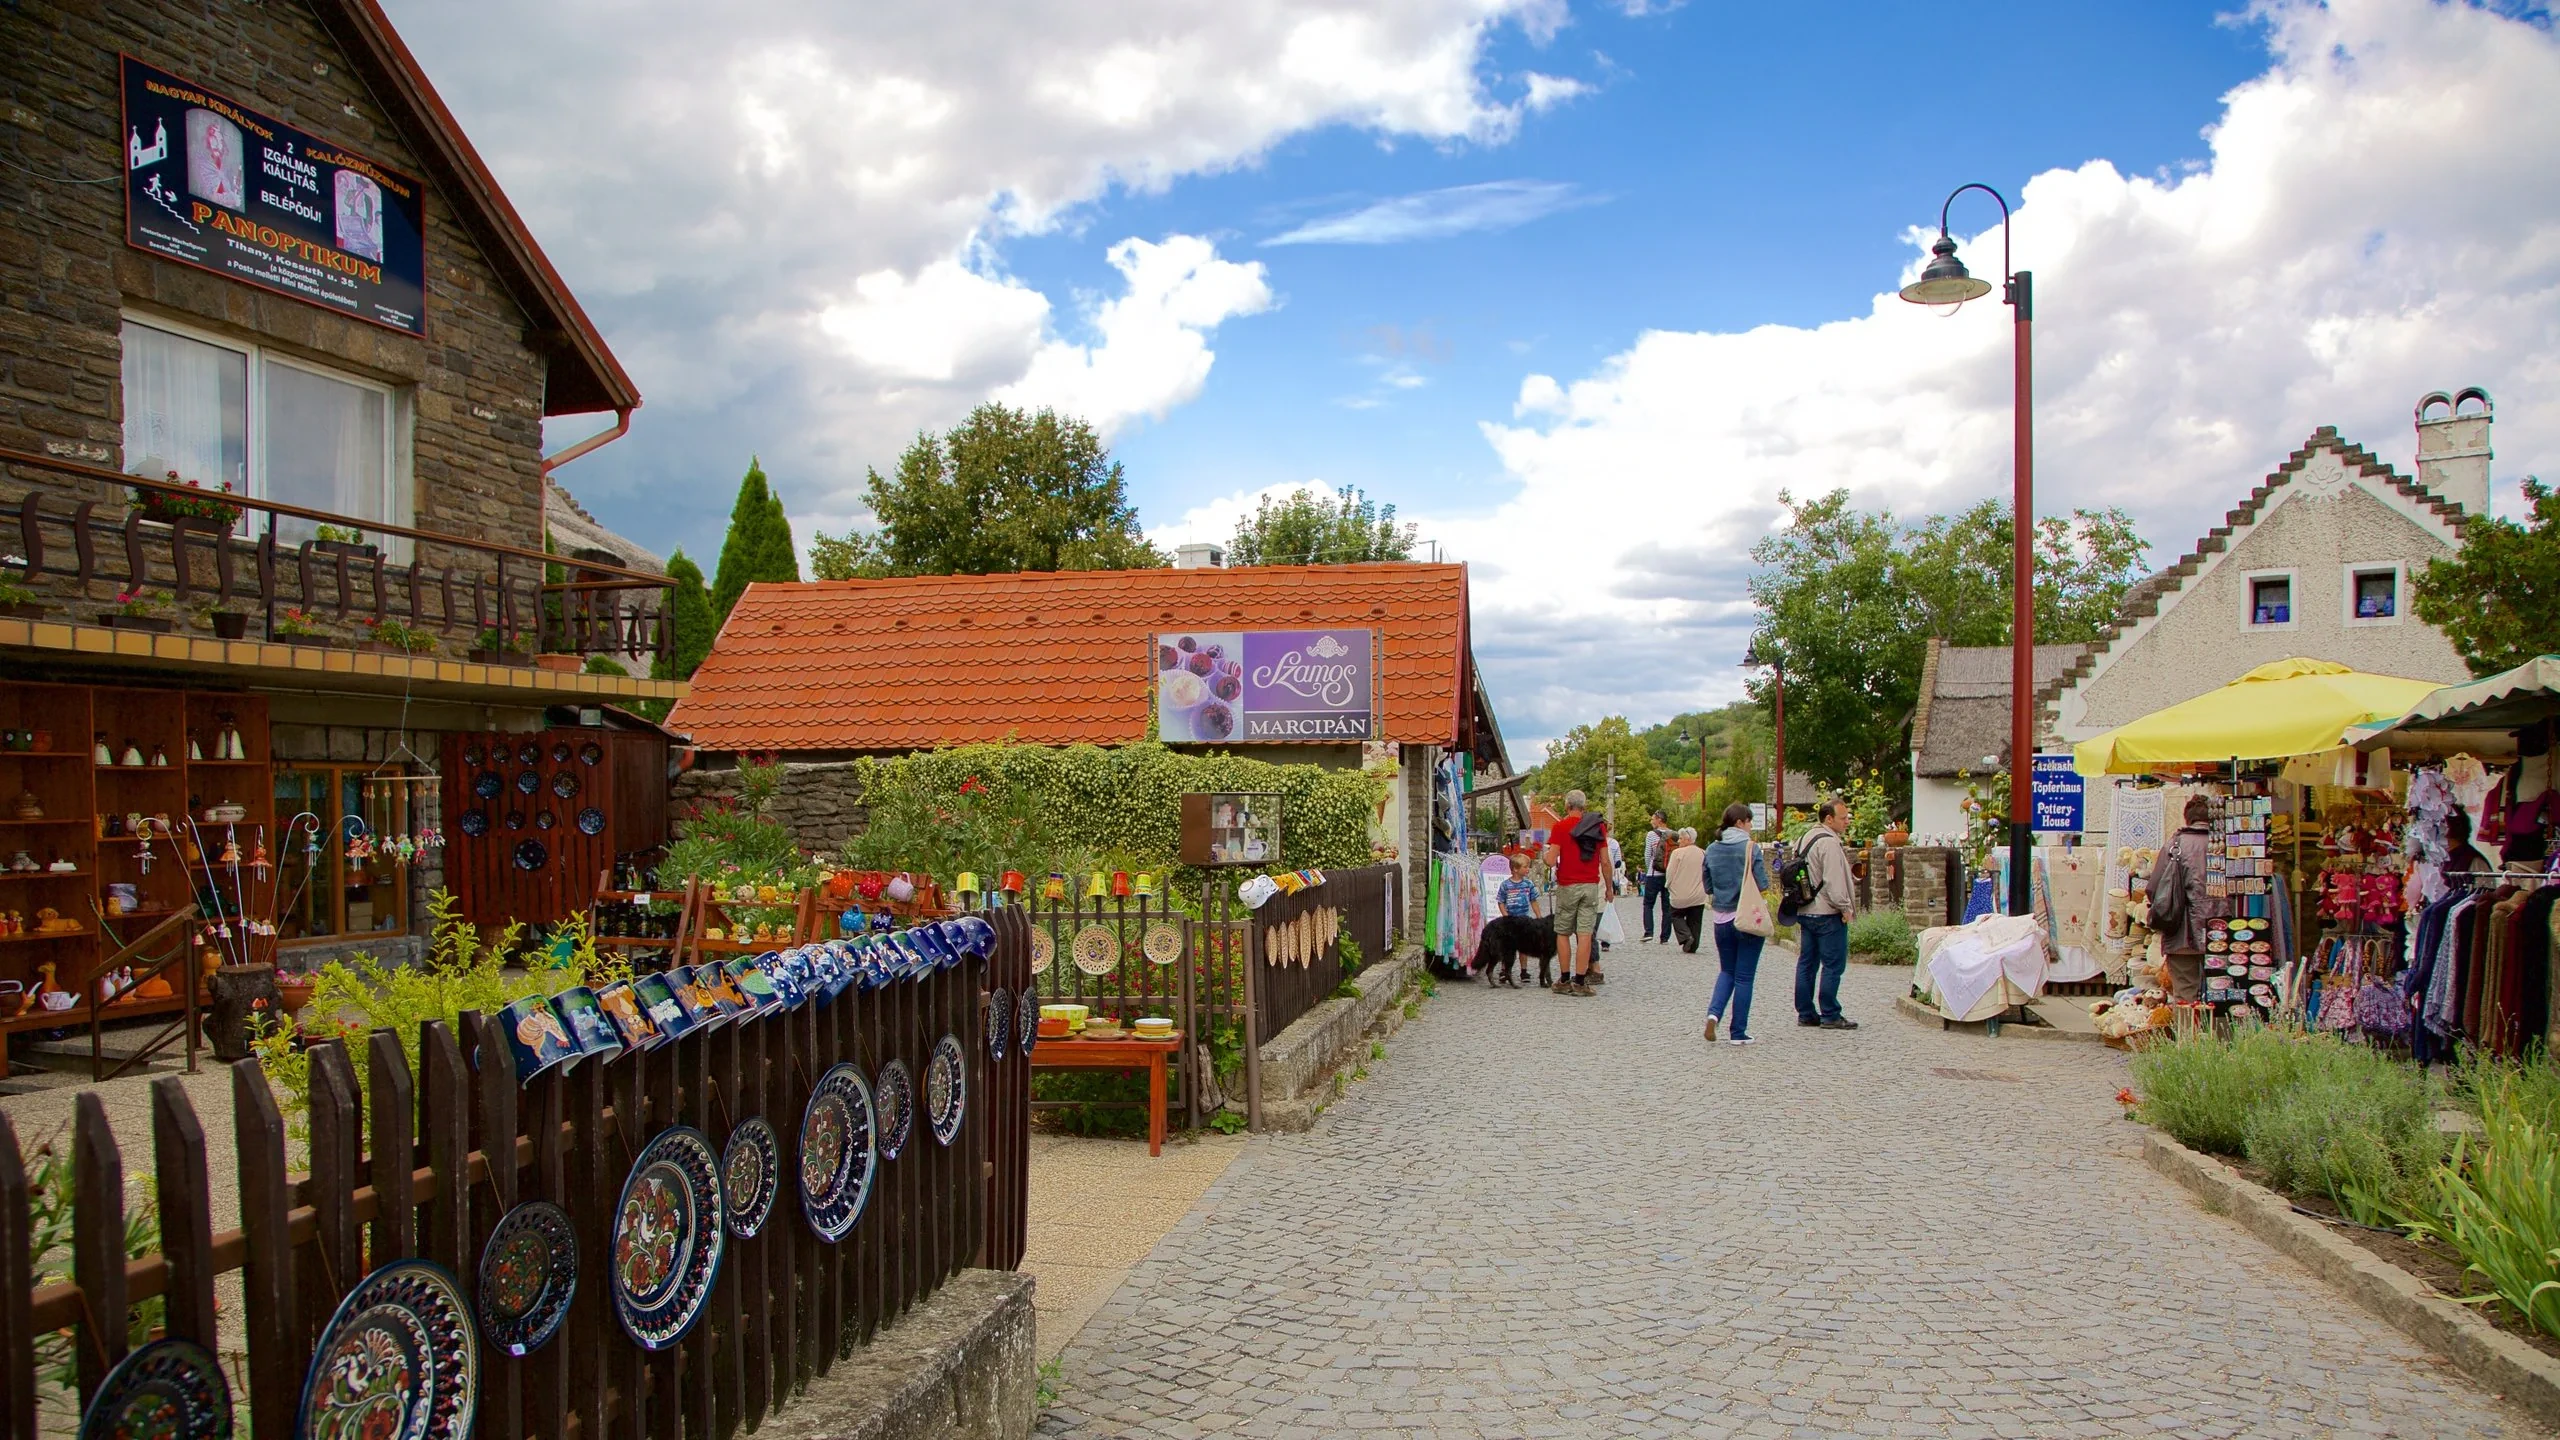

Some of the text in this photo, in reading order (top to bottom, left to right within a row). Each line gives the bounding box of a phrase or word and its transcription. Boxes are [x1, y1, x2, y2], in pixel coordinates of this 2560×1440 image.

[145, 79, 273, 141] MAGYAR KIRÁLYOK
[263, 147, 318, 177] IZGALMAS
[287, 141, 294, 154] 2
[263, 162, 320, 195] KIÁLLÍTÁS,
[305, 147, 410, 199] KALÓZMÚZEUM
[261, 190, 322, 223] BELÉPŐDÍJ!
[289, 186, 295, 198] 1
[192, 201, 382, 285] PANOPTIKUM
[226, 238, 272, 261] Tihany,
[275, 255, 324, 278] Kossuth
[326, 273, 338, 283] u.
[233, 260, 254, 274] Posta
[1252, 651, 1357, 706] Szamos
[1250, 715, 1366, 735] MARCIPÁN
[2032, 780, 2082, 796] Töpferhaus
[2037, 801, 2076, 816] Pottery-
[2042, 814, 2071, 827] House
